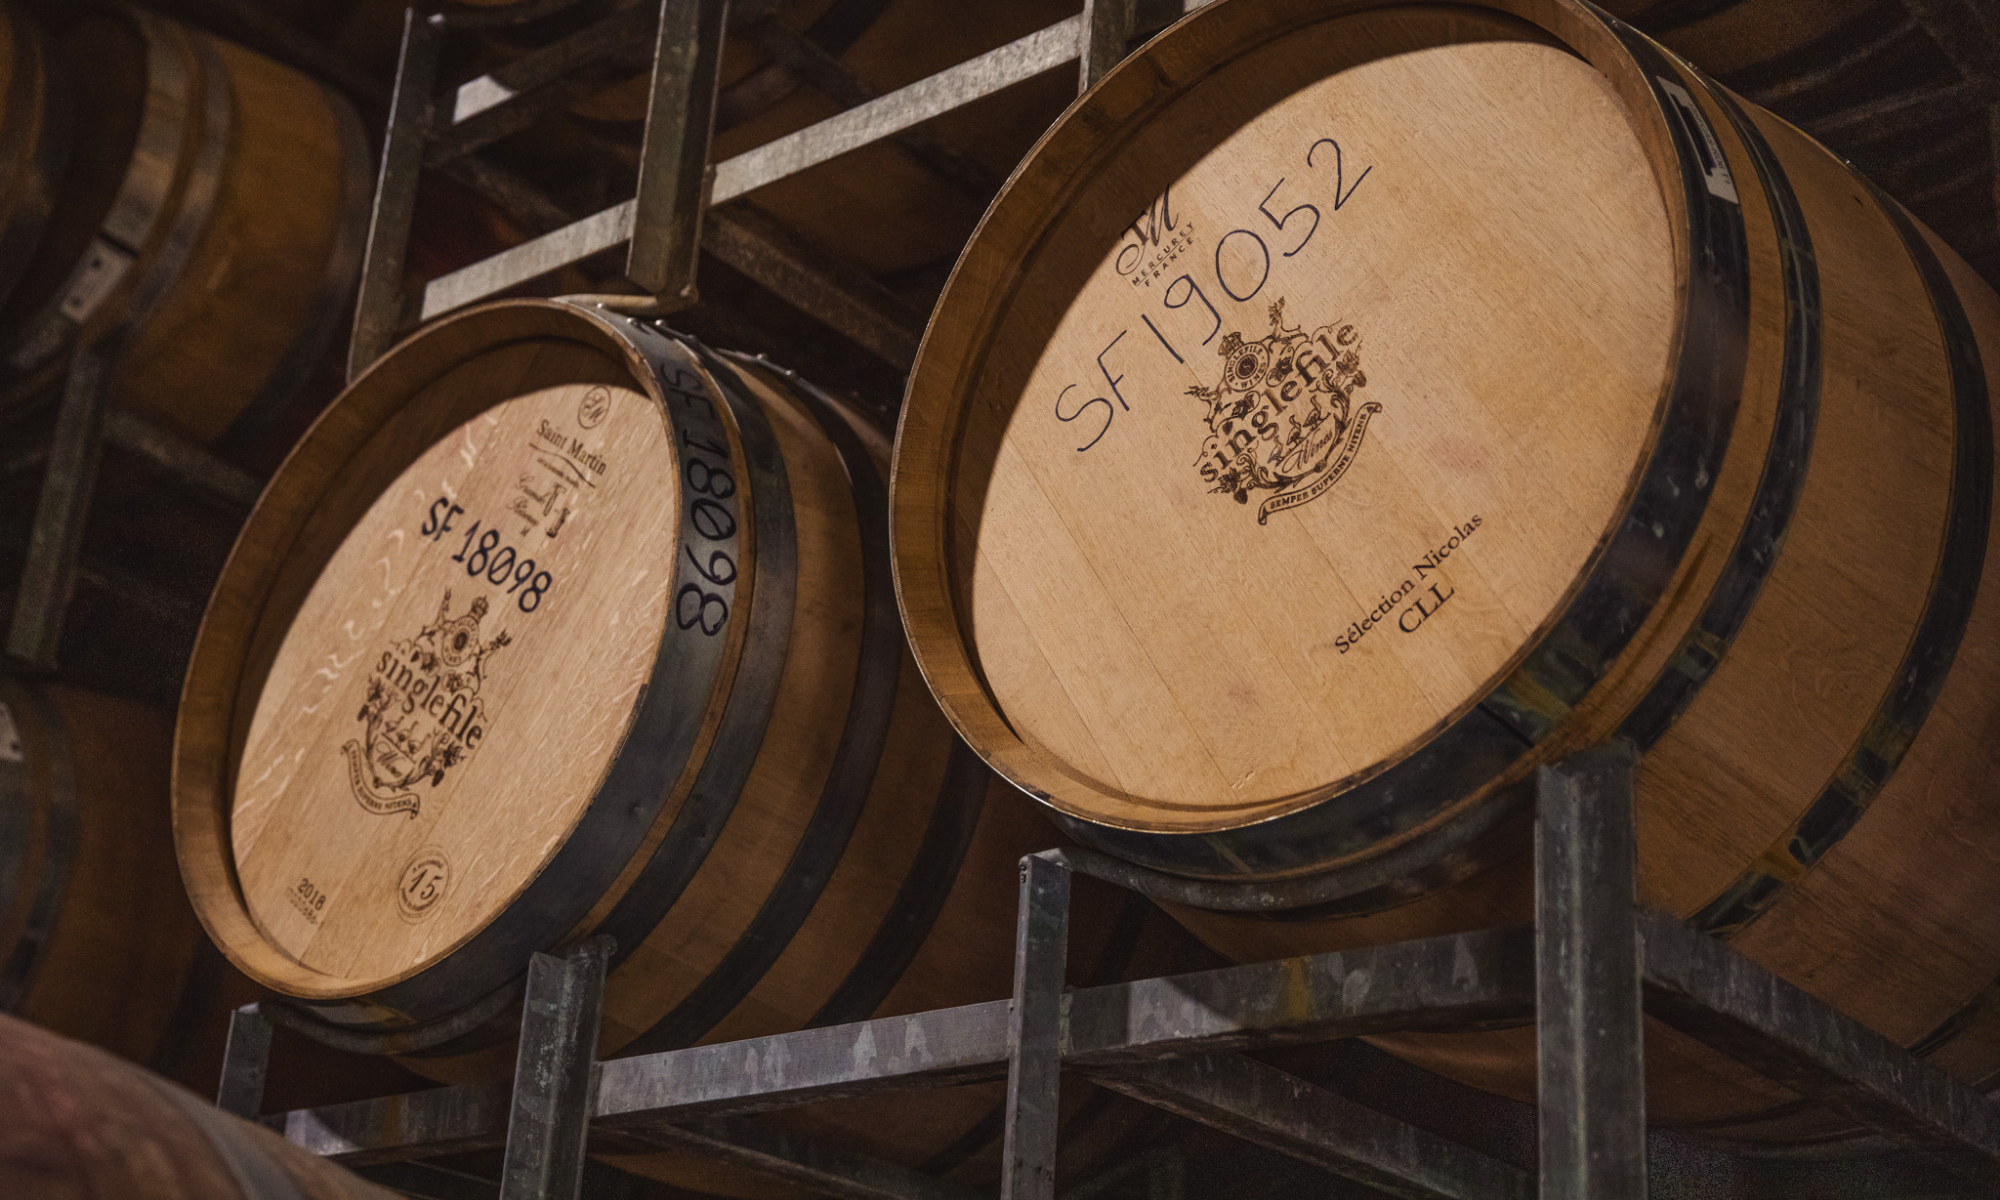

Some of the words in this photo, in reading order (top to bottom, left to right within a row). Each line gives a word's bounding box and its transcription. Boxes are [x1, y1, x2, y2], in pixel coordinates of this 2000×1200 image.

[1132, 221, 1195, 286] MERCUREY
[1144, 237, 1194, 287] FRANCE
[1200, 324, 1358, 483] singlefile
[536, 419, 568, 450] Saint
[566, 438, 607, 476] Martin
[1334, 579, 1416, 655] Sélection
[1412, 514, 1483, 581] Nicolas
[1398, 582, 1455, 634] CLL
[376, 651, 483, 749] singlefile
[297, 877, 327, 912] 2018
[408, 869, 443, 900] 15
